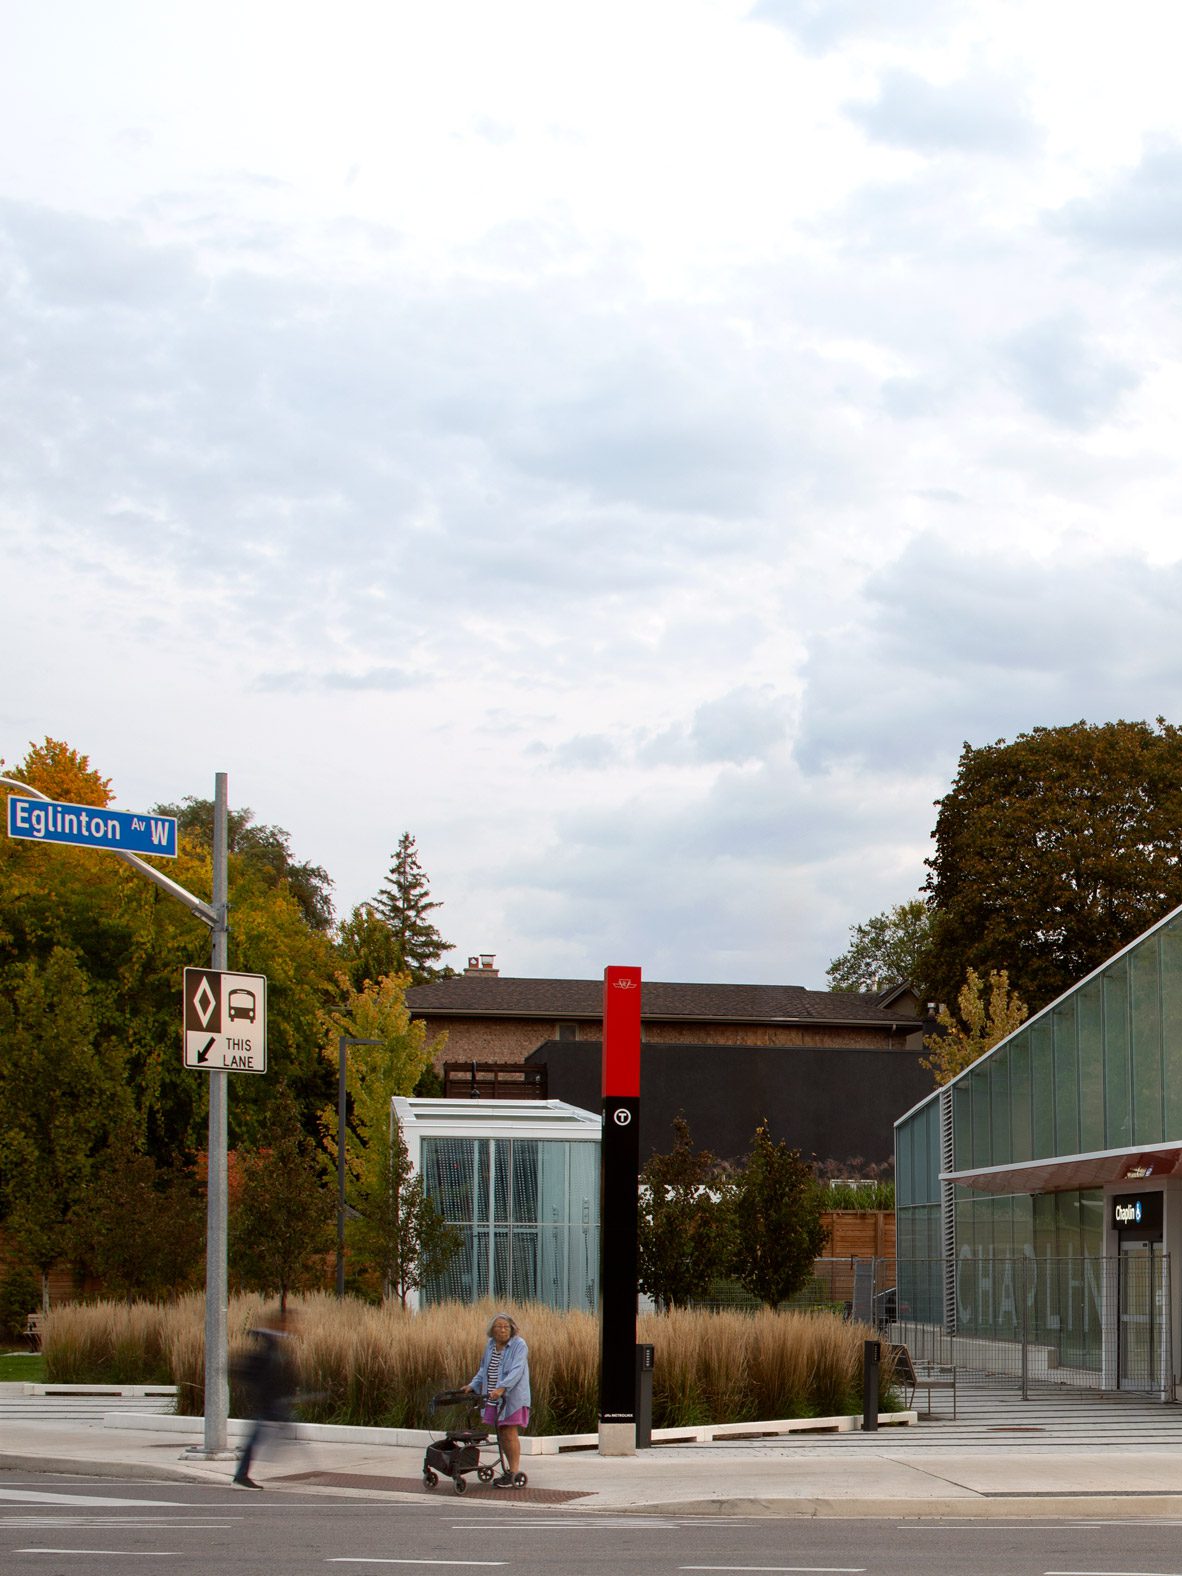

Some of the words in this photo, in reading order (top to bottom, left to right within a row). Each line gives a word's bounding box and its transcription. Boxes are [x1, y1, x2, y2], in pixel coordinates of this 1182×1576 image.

[16, 802, 121, 840] Eglinton
[131, 817, 146, 832] Av
[151, 820, 170, 846] W
[226, 1037, 252, 1052] THIS
[223, 1054, 254, 1069] LANE
[1115, 1204, 1135, 1225] Chaplin
